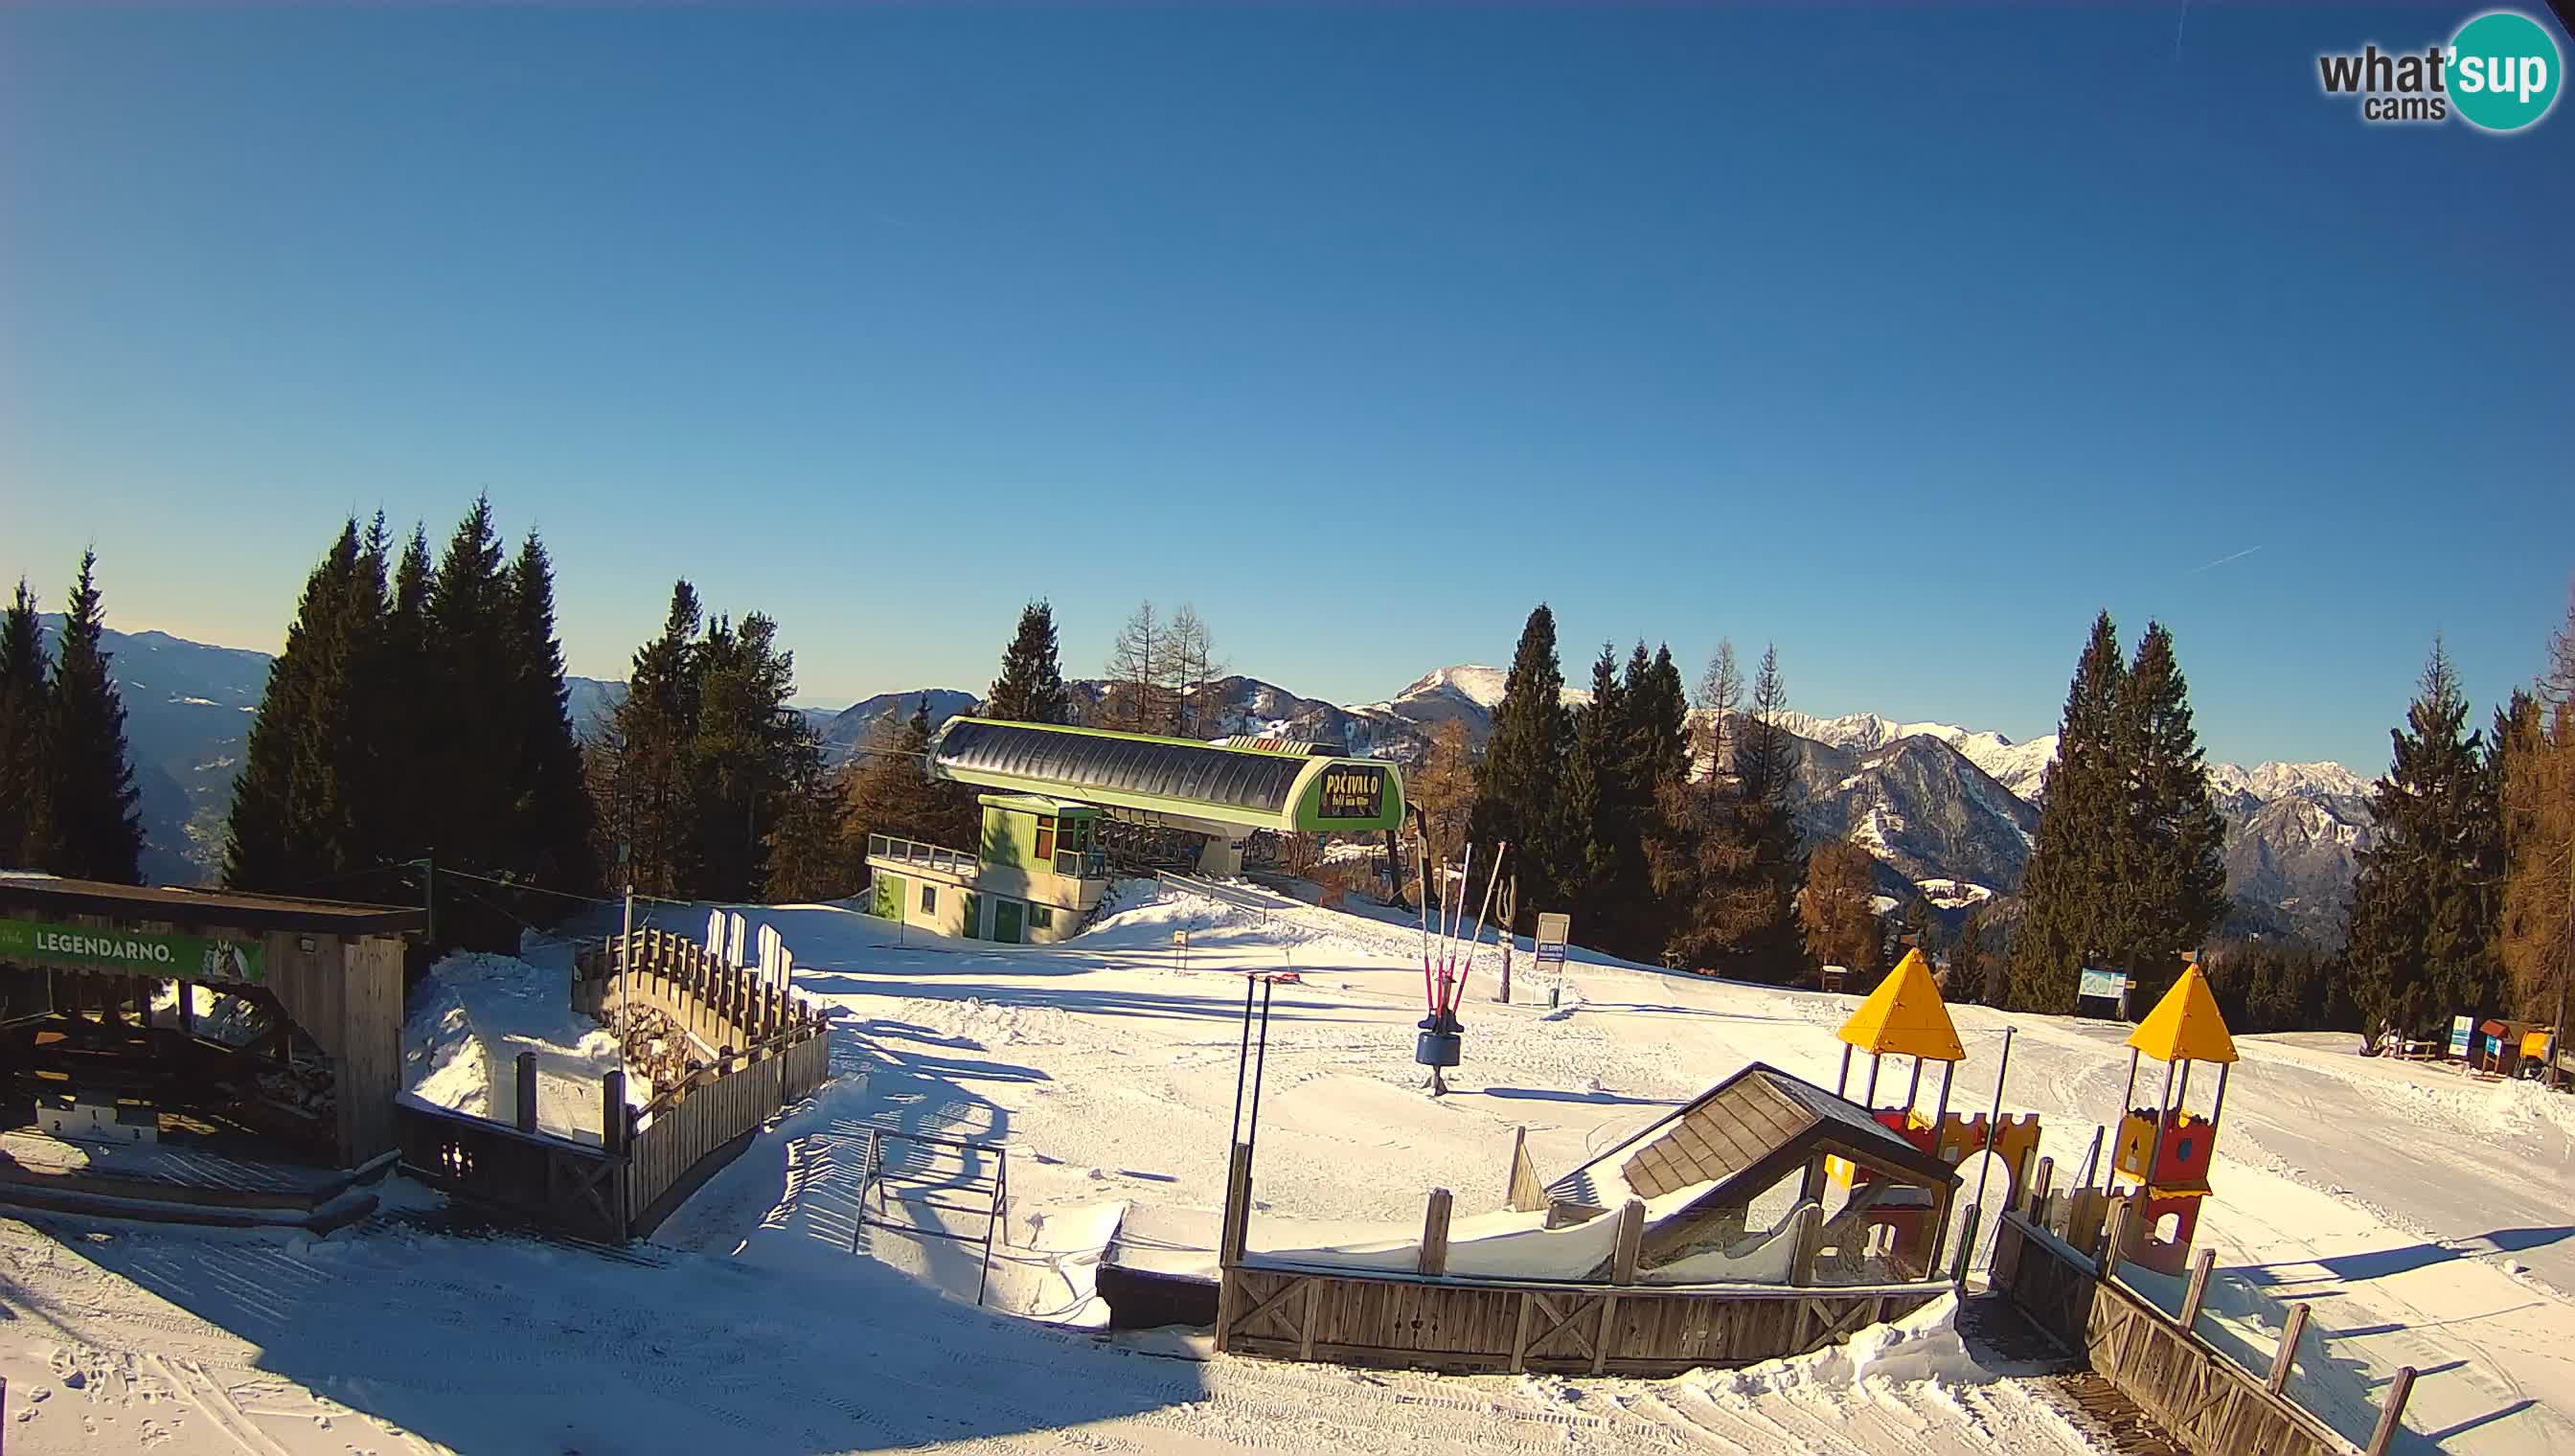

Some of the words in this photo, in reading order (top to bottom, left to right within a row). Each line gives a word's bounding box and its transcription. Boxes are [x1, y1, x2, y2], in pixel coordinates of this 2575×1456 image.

[36, 931, 175, 963] LEGENDARNO.
[54, 1120, 62, 1131] 2
[132, 1128, 141, 1140] 3
